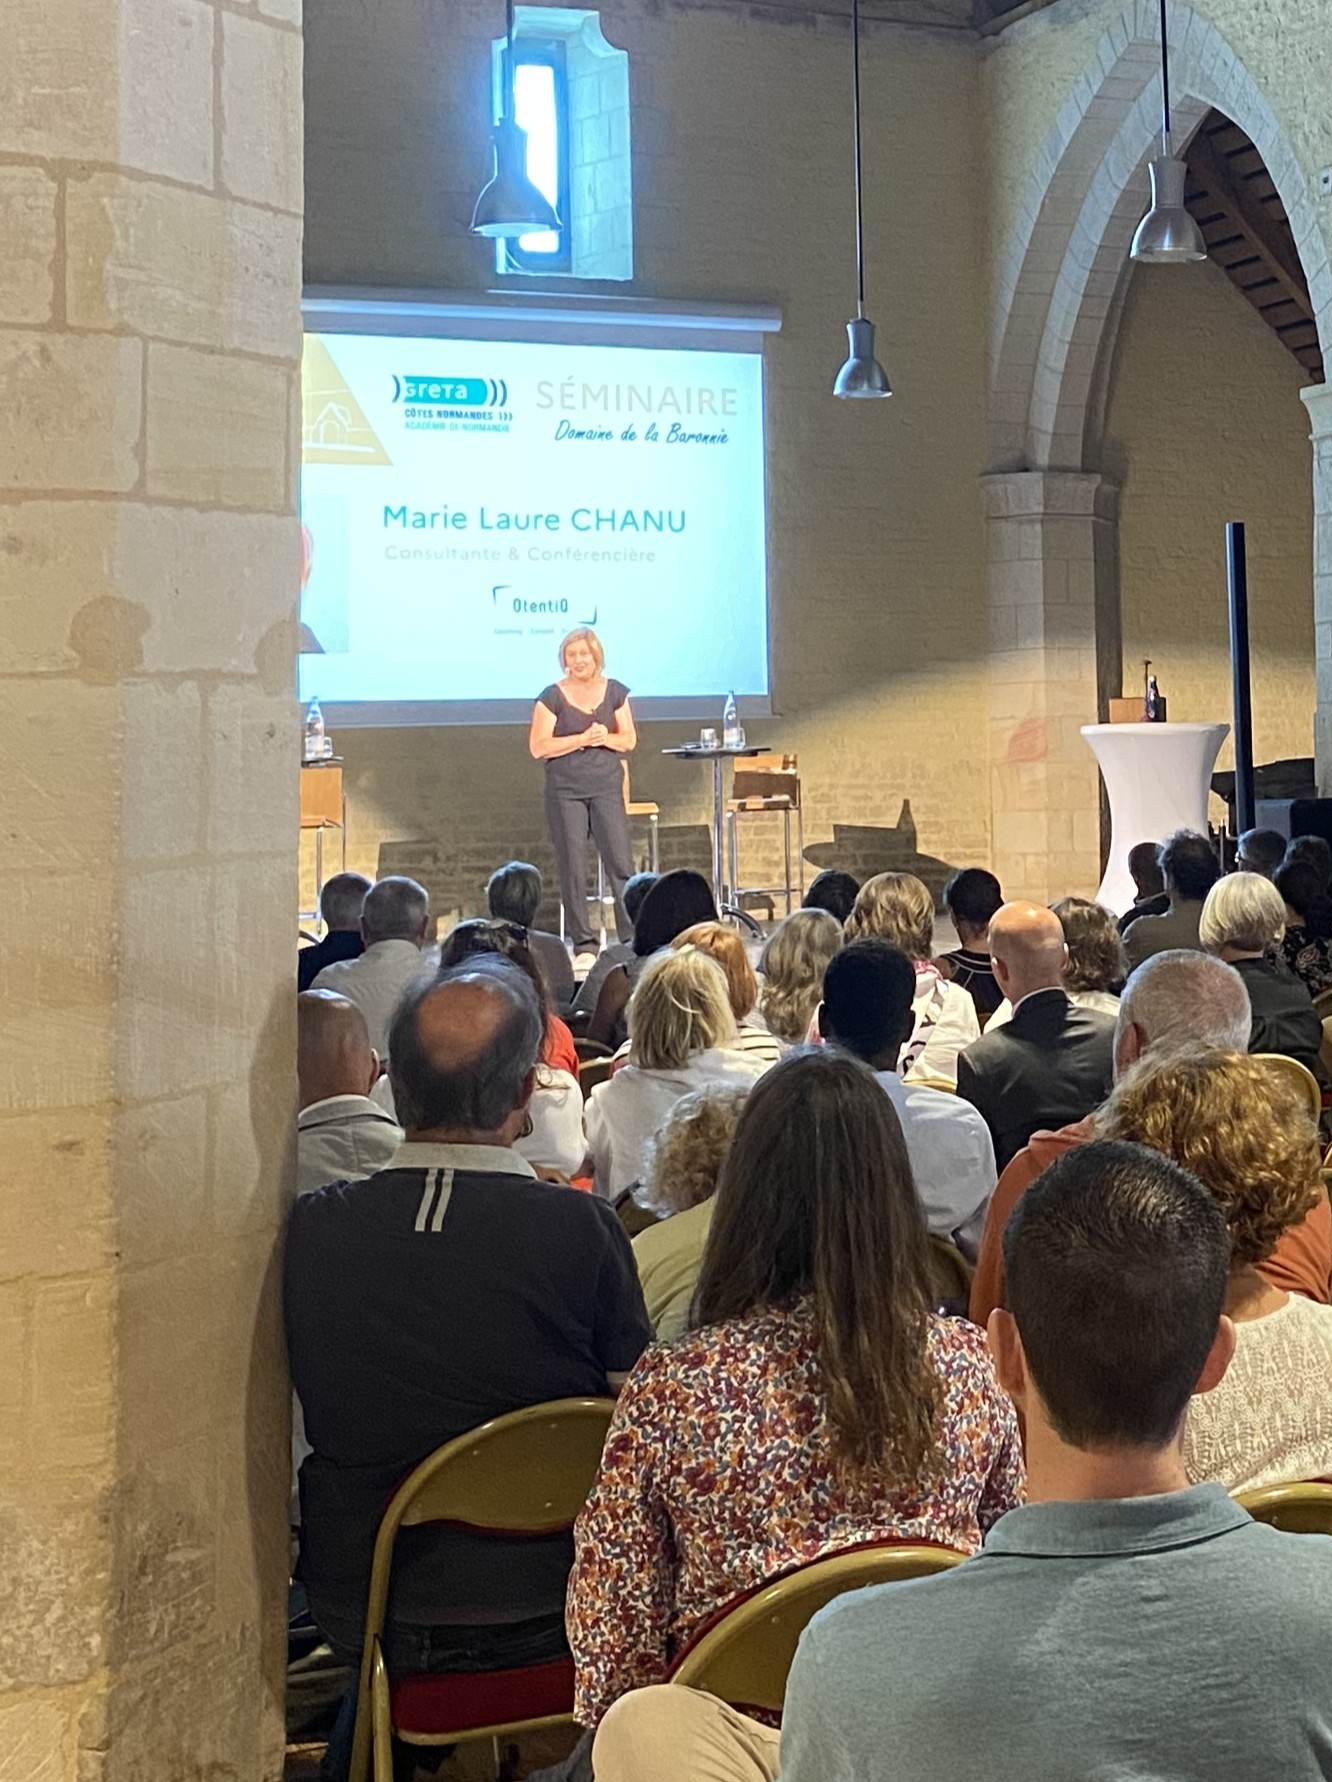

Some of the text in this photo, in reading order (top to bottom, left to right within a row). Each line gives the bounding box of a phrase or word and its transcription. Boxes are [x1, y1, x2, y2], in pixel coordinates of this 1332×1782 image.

[536, 376, 738, 416] SÉMINAIRE
[404, 407, 493, 420] CÔTES NORMANDES
[554, 419, 729, 444] Domaine de la Baronnie
[383, 504, 686, 533] Marie Laure CHANU
[385, 545, 656, 563] Consultante & Conférencière
